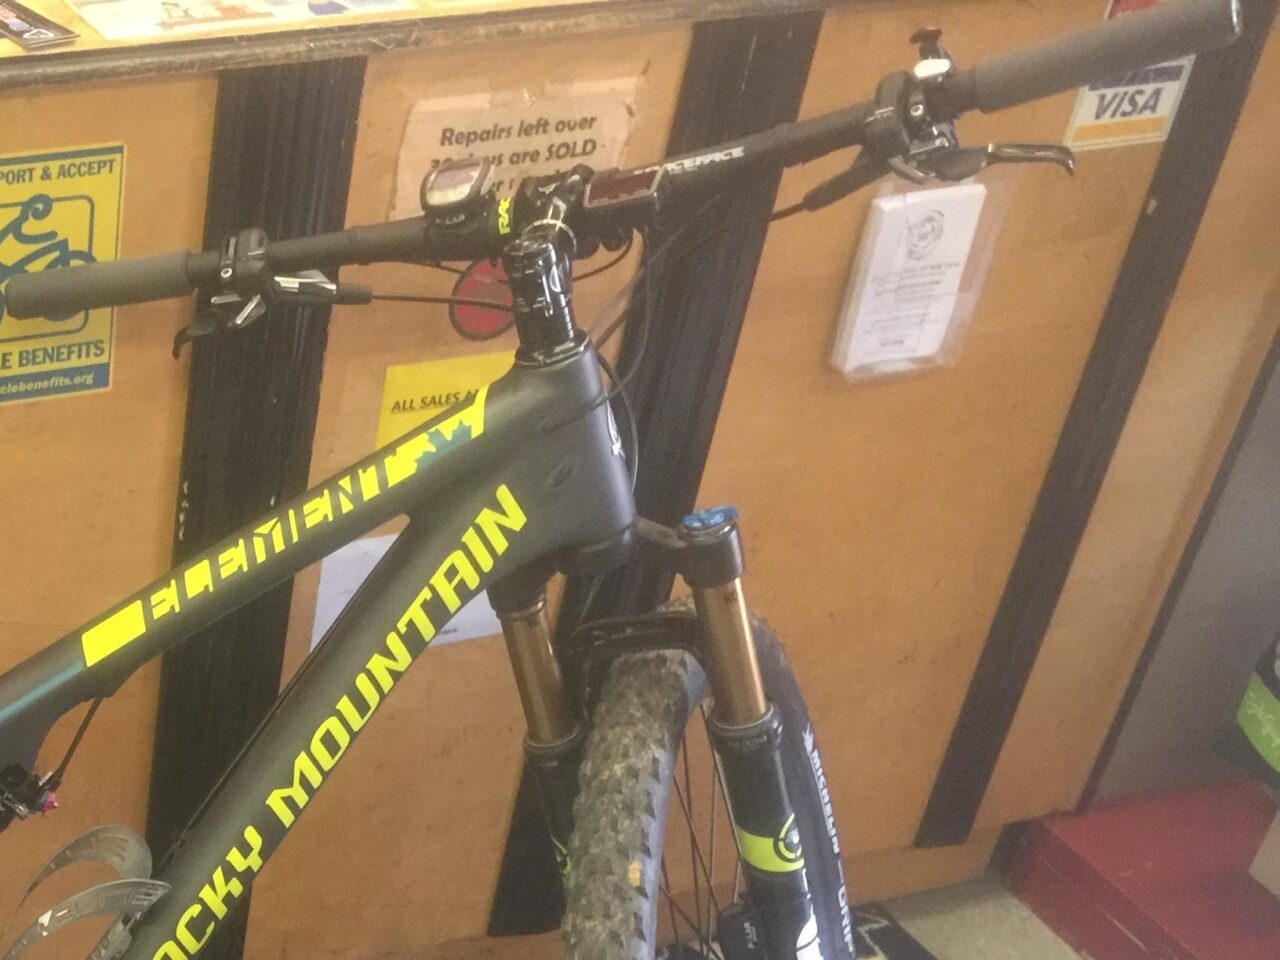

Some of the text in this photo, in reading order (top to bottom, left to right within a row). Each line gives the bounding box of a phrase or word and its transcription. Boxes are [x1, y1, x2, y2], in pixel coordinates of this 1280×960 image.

[1095, 87, 1164, 120] VISA
[440, 116, 597, 147] Repairs left over
[509, 150, 541, 165] are
[546, 139, 597, 161] SOLD
[40, 164, 52, 182] &
[57, 158, 117, 180] ACCEPT
[19, 339, 105, 368] BENEFITS
[390, 397, 417, 415] ALL
[419, 391, 461, 409] SALES
[265, 483, 527, 829] MOUNTAIN
[811, 747, 840, 854] MICHELIN
